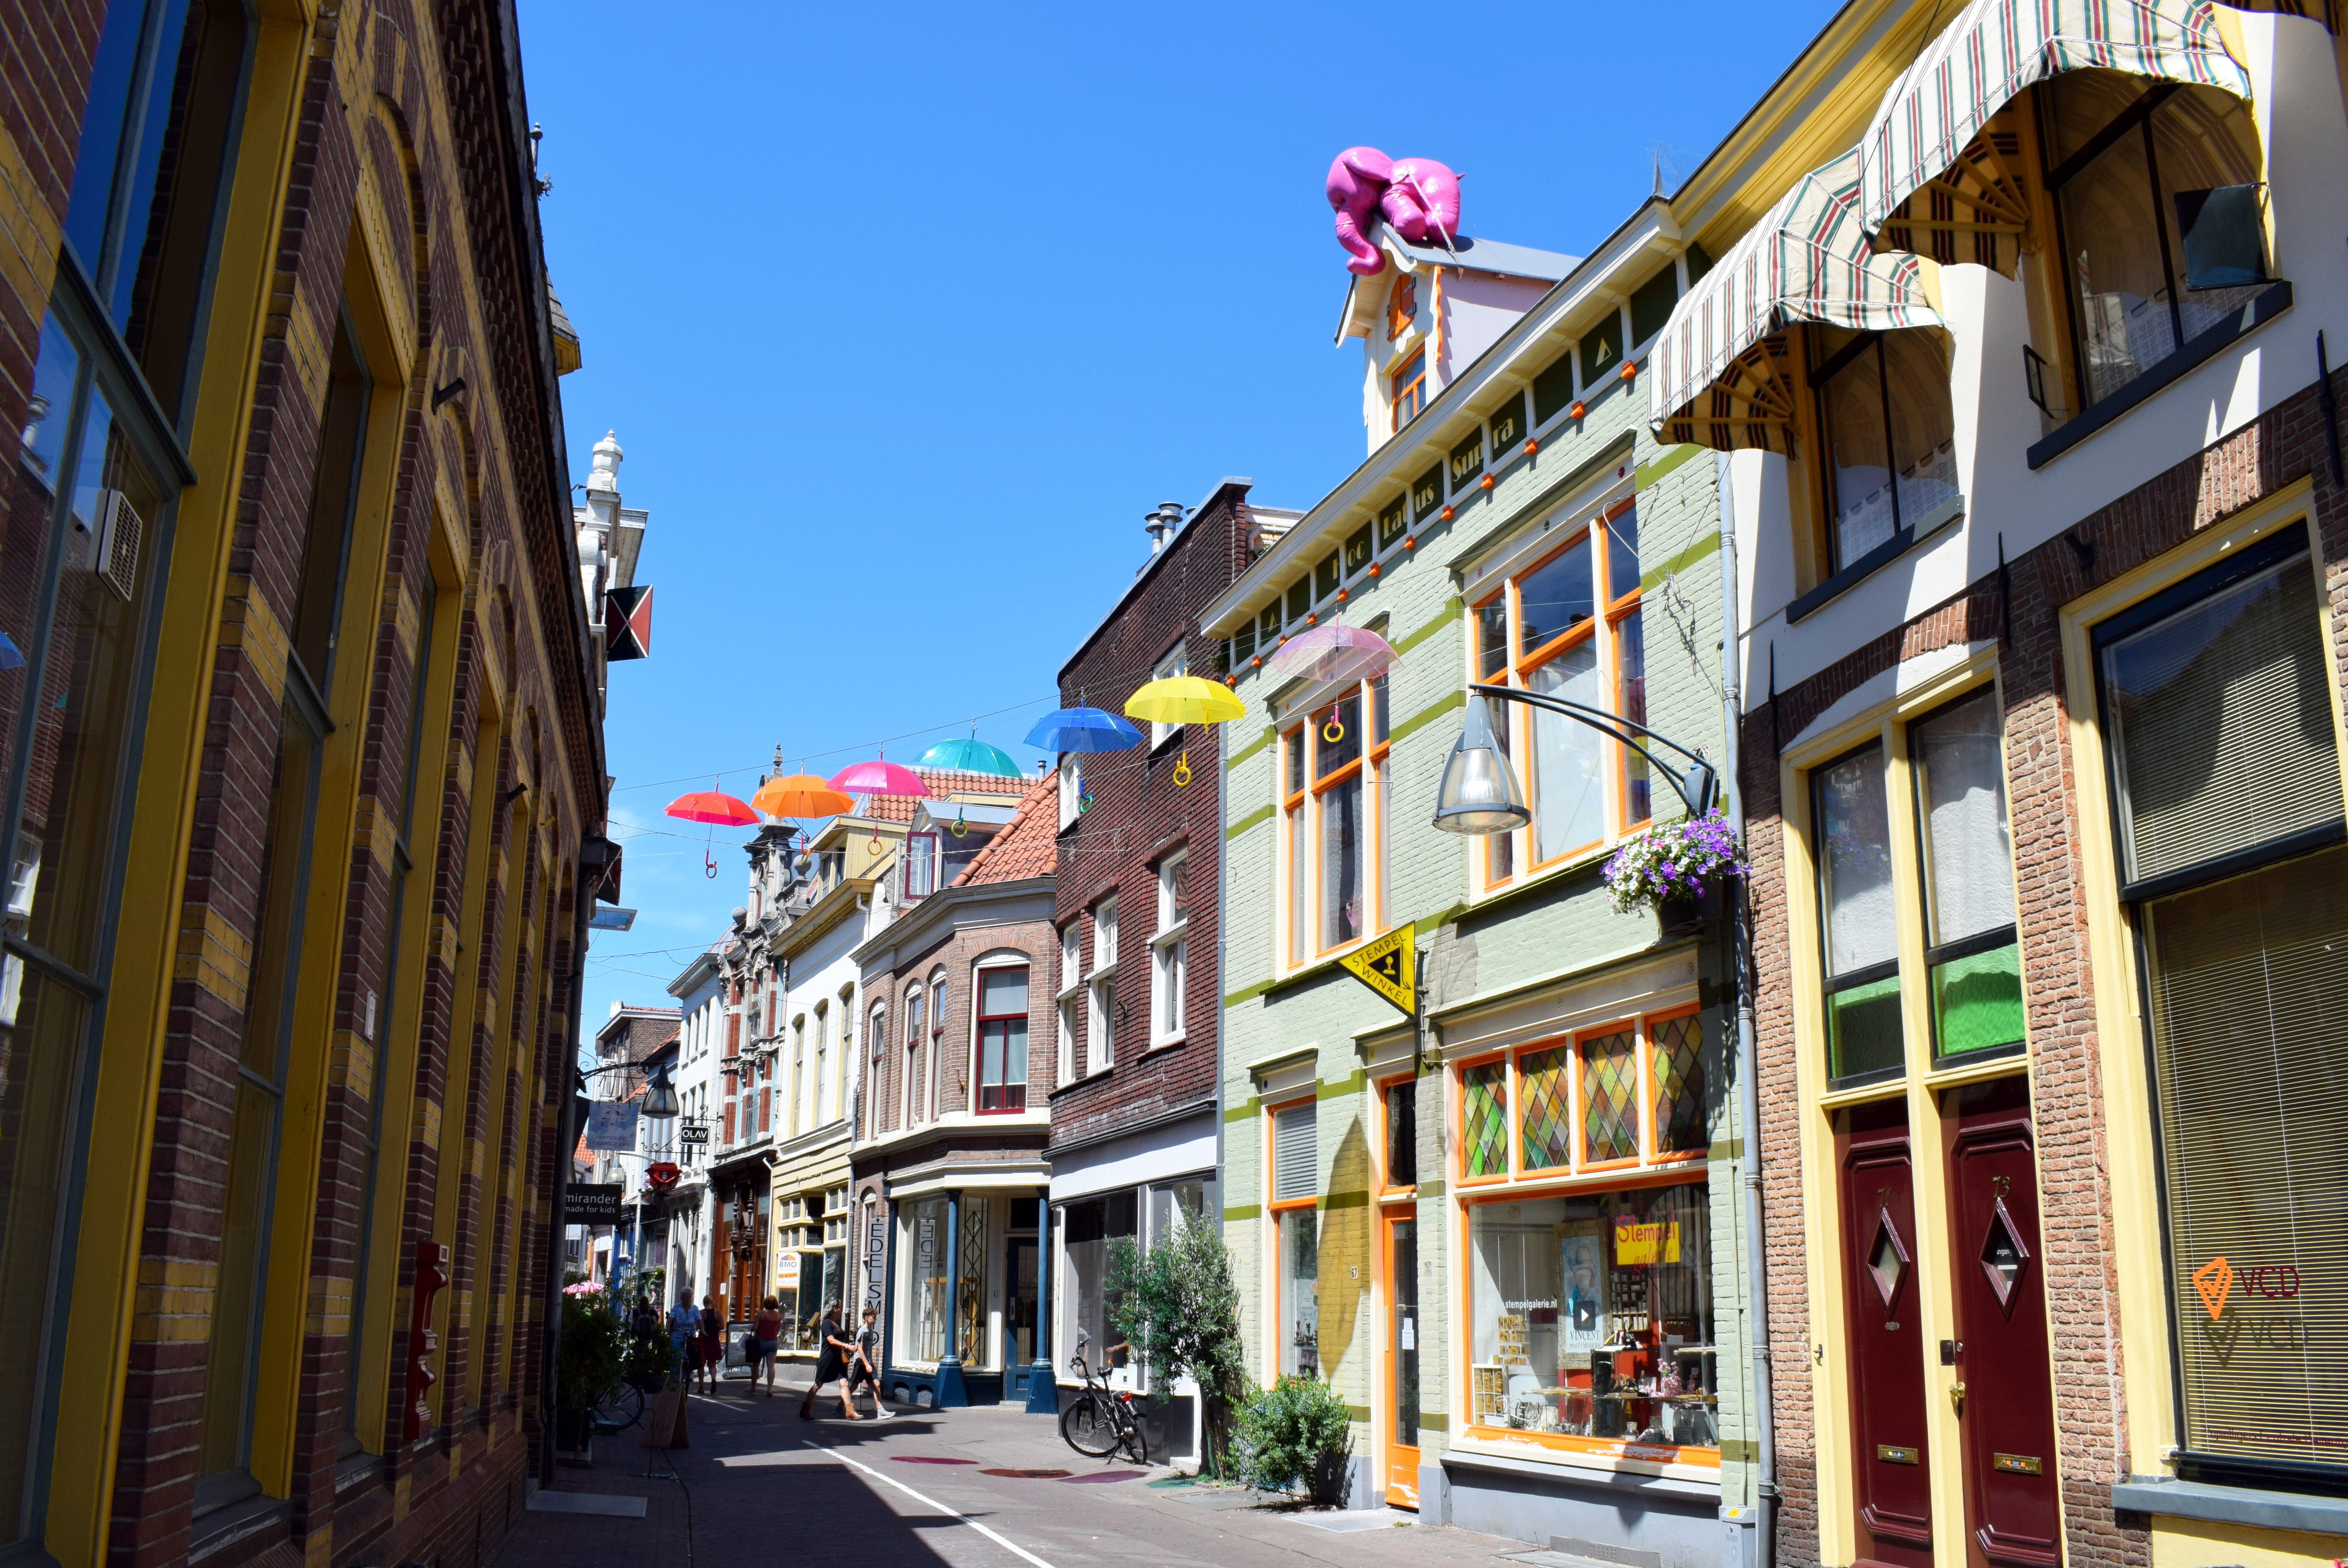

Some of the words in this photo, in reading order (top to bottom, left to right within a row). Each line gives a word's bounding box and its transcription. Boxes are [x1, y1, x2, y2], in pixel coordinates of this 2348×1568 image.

[1384, 484, 1434, 540] Latus
[1452, 418, 1514, 482] Supra
[1352, 933, 1406, 967] STEMPEL
[1362, 966, 1407, 1006] WINKEL
[682, 1130, 708, 1138] OLAV
[565, 1193, 616, 1204] mirander
[1618, 1212, 1675, 1245] Stempel
[1352, 1268, 1357, 1278] 67
[2238, 1266, 2300, 1297] VCD
[1491, 1299, 1557, 1311] www.stempelgalerie.nl
[1570, 1330, 1599, 1340] VINCENT
